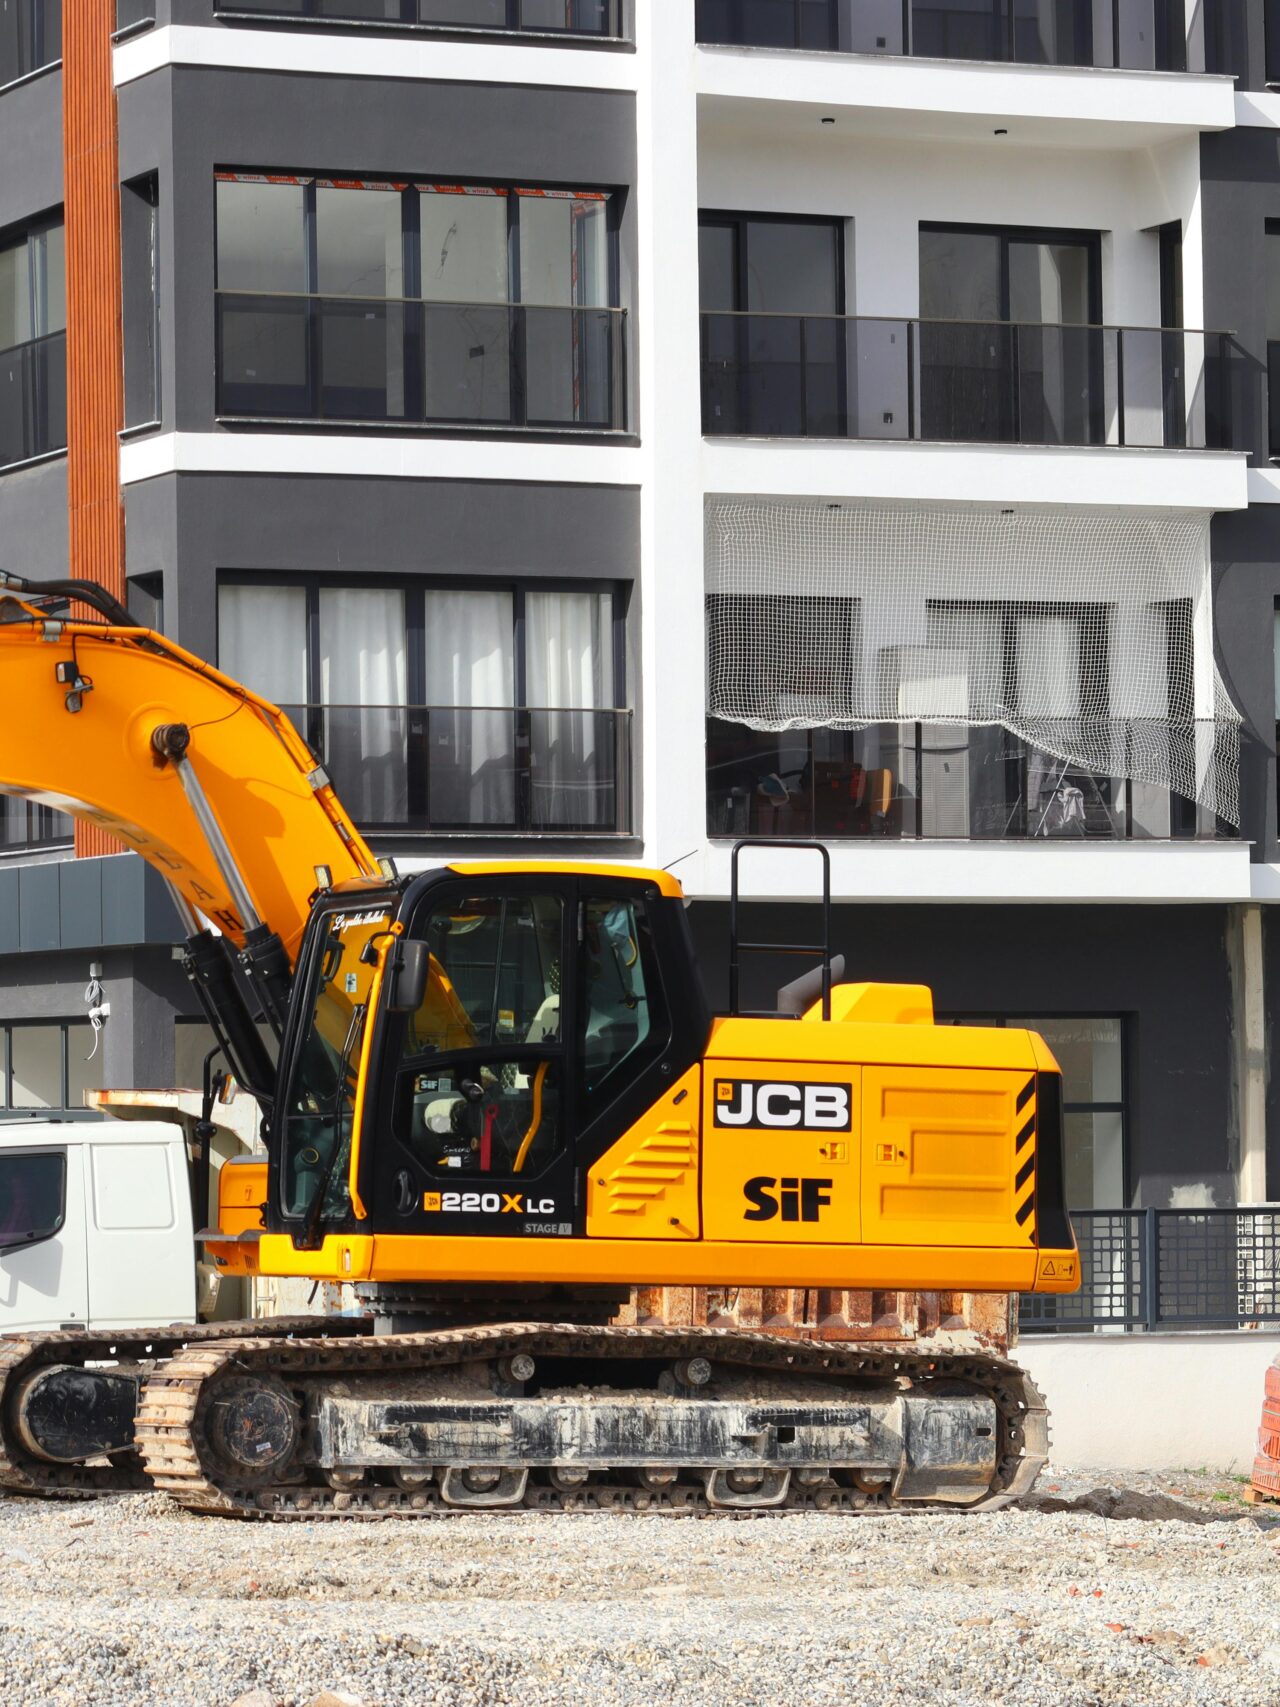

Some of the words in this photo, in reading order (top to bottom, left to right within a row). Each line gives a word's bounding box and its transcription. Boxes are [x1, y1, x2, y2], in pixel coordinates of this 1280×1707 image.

[716, 1083, 849, 1128] JCB
[526, 1199, 555, 1213] LC
[525, 1223, 558, 1233] STAGE
